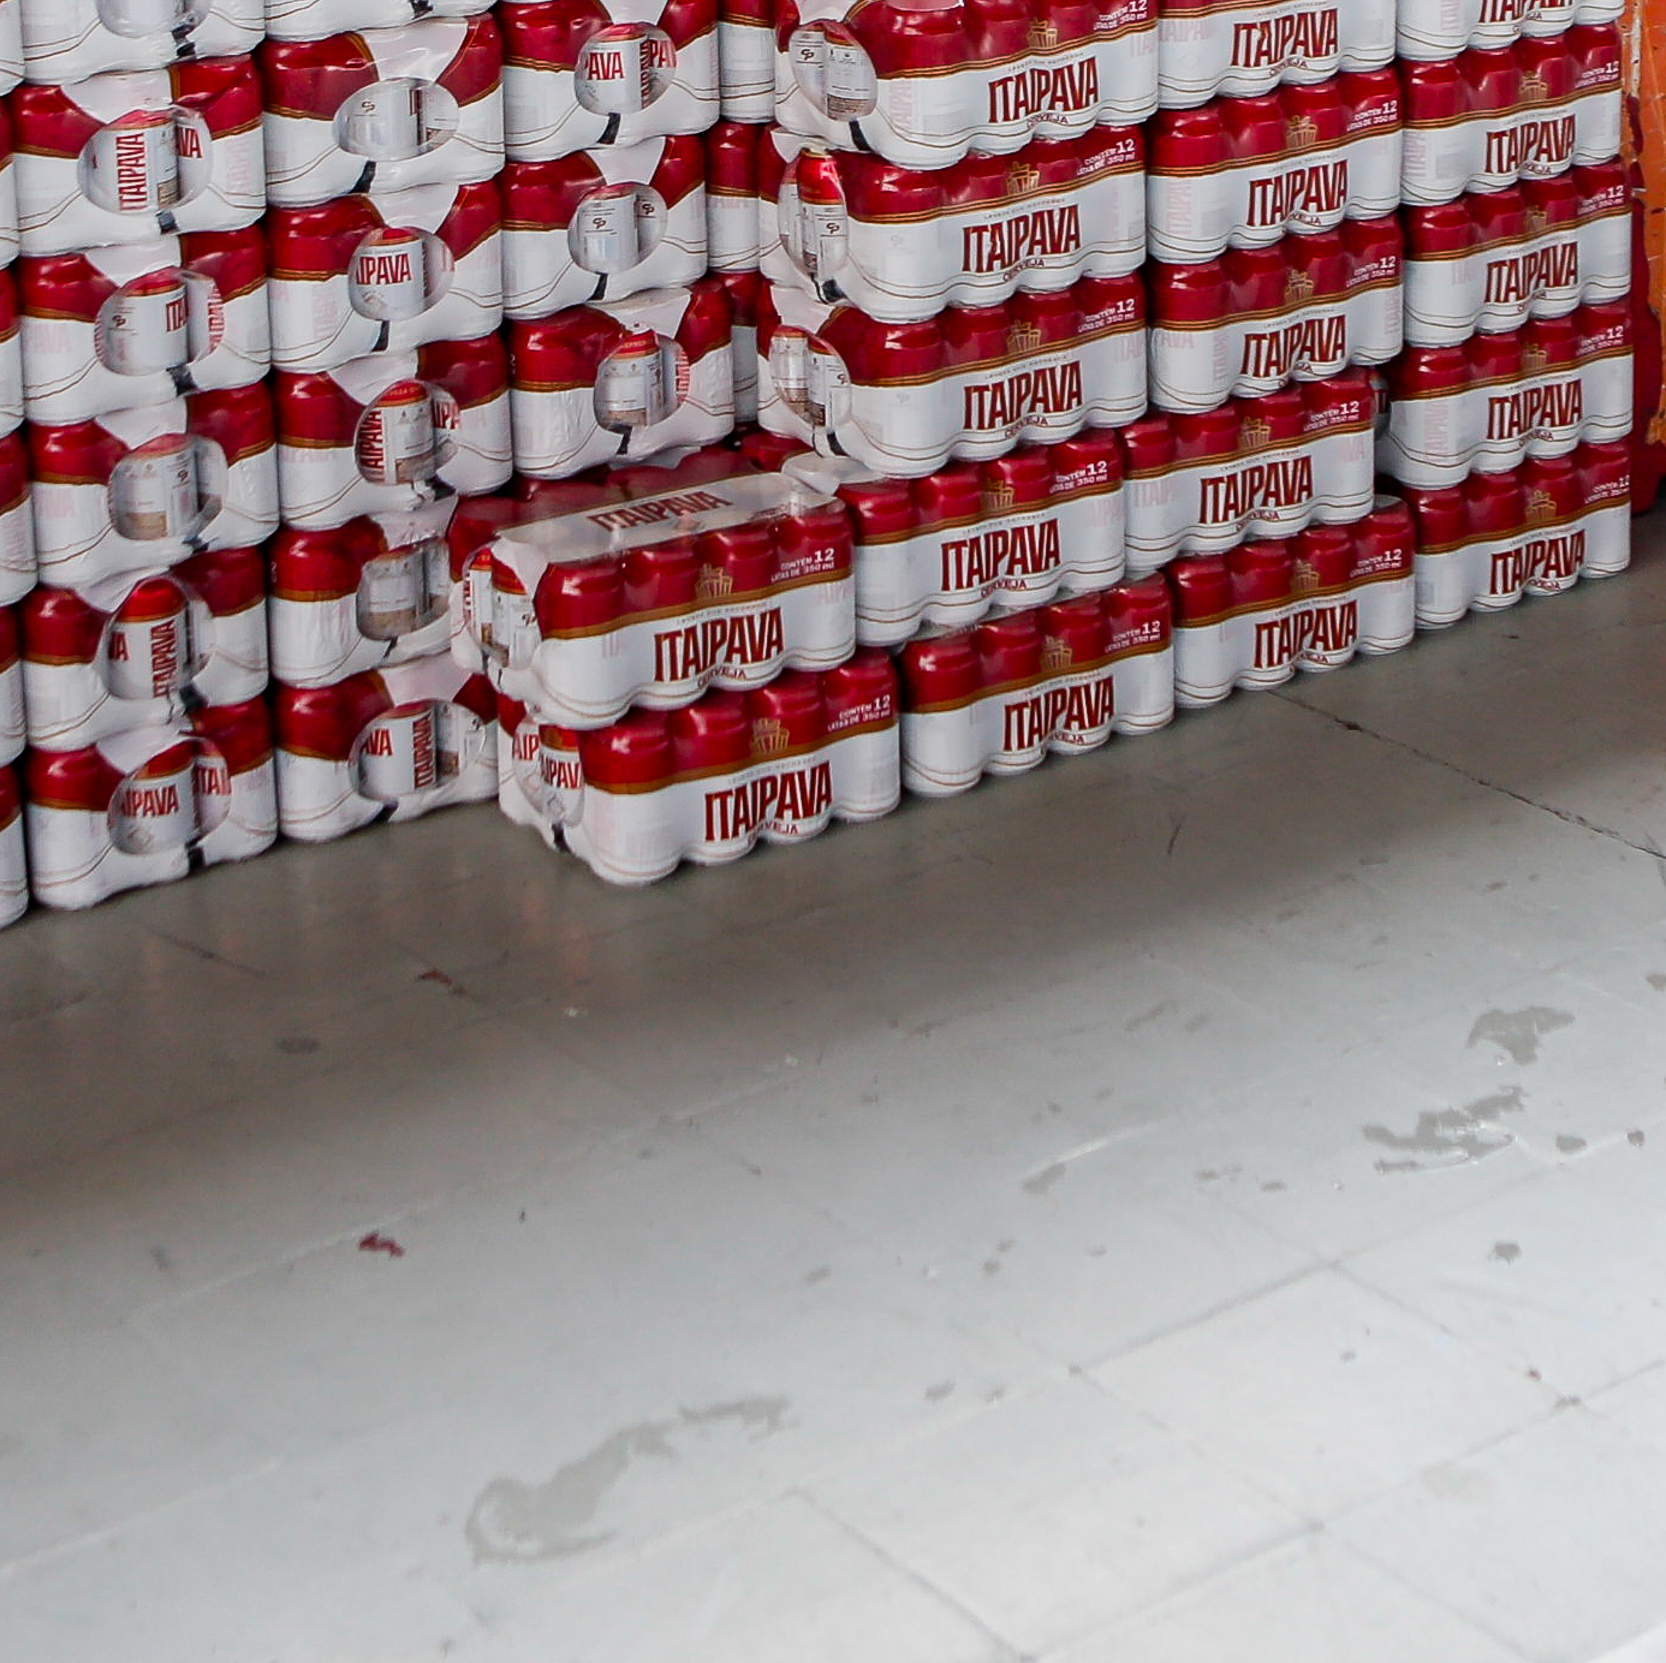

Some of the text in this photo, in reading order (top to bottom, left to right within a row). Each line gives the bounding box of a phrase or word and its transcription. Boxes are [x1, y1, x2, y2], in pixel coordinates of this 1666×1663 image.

[1232, 8, 1338, 68] ITAIPAVA
[1603, 61, 1620, 74] 12
[988, 57, 1100, 124] ITAIPAVA
[1380, 100, 1398, 115] 12
[116, 133, 148, 211] ITAIPAVA
[1116, 139, 1135, 152] 12
[1485, 114, 1576, 175] ITAIPAVA
[1248, 159, 1348, 227] ITAIPAVA
[1607, 185, 1624, 198] 12
[962, 204, 1082, 273] ITAIPAVA
[1379, 255, 1396, 270] 12
[1485, 241, 1578, 304] ITAIPAVA
[1116, 299, 1135, 313] 12
[1606, 325, 1624, 340] 12
[1241, 315, 1347, 378] ITAIPAVA
[963, 361, 1083, 430] ITAIPAVA
[1340, 401, 1359, 416] 12
[1487, 379, 1583, 441] ITAIPAVA
[1086, 461, 1108, 476] 12
[1199, 455, 1313, 525] ITAIPAVA
[588, 491, 732, 531] ITAIPAVA
[814, 548, 835, 563] 12
[940, 518, 1062, 592] ITAIPAVA
[1383, 549, 1402, 563] 12
[1489, 529, 1585, 595] ITAIPAVA
[653, 607, 784, 682] ITAIPAVA
[1141, 619, 1161, 635] 12
[1253, 600, 1358, 670] ITAIPAVA
[150, 619, 177, 699] ITAIPAVA
[873, 695, 892, 710] 12
[1003, 674, 1114, 752] ITAIPAVA
[704, 761, 832, 843] ITAIPAVA
